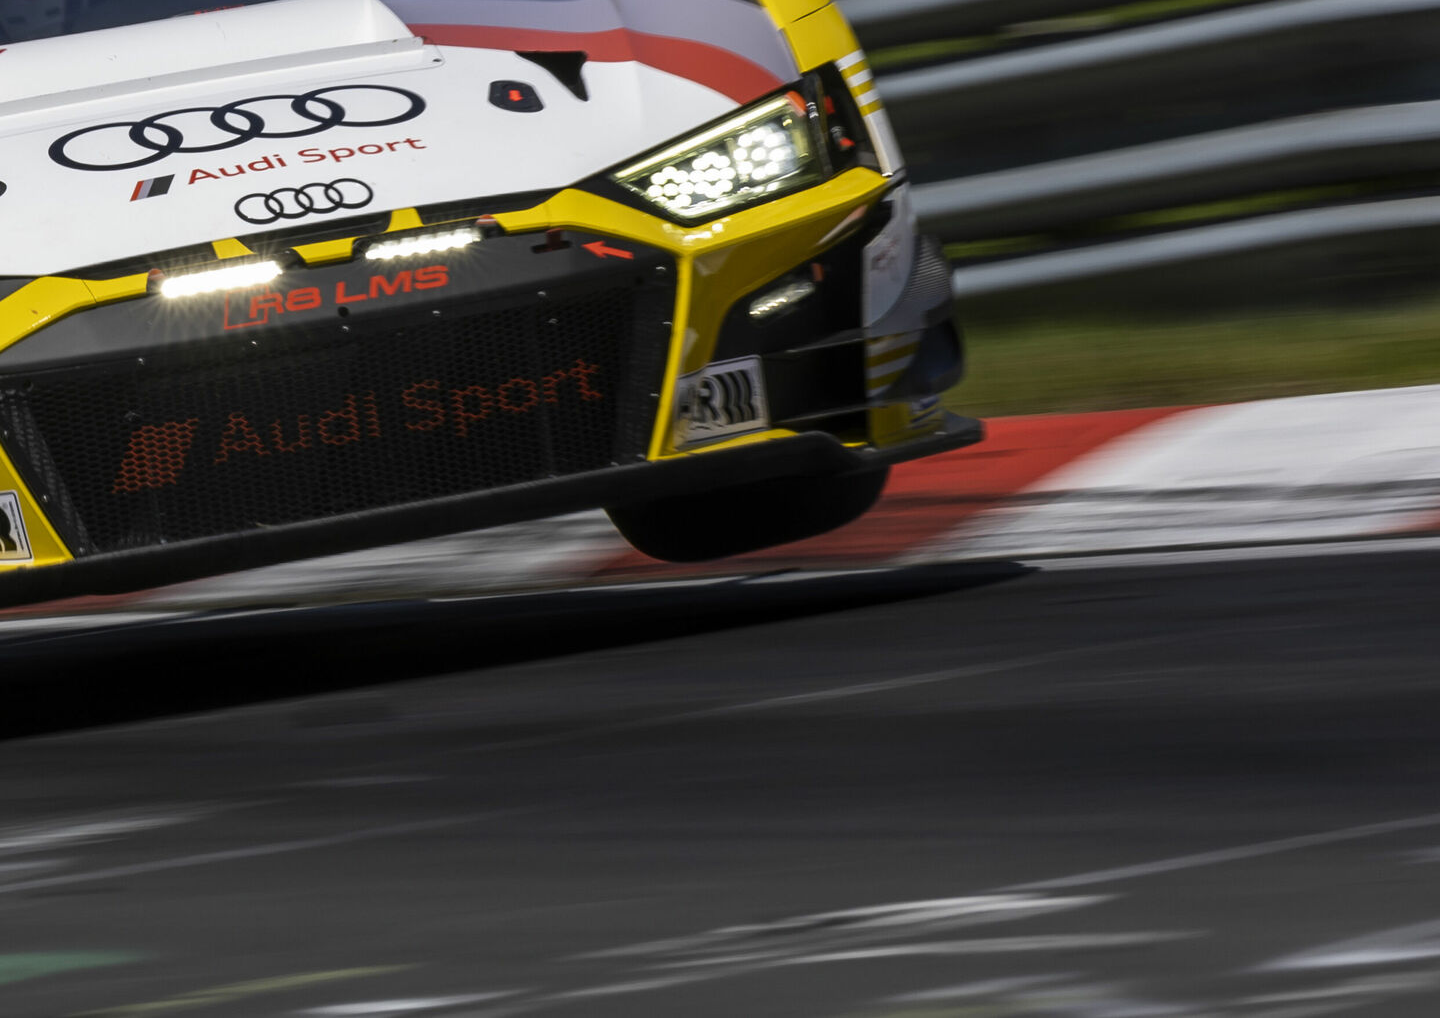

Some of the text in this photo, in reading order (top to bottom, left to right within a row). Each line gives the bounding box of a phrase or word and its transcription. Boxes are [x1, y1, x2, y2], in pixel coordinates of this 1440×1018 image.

[188, 136, 427, 185] Audi Sport
[248, 264, 449, 320] R8 LMS
[214, 391, 382, 465] Audi
[402, 358, 603, 437] Sport
